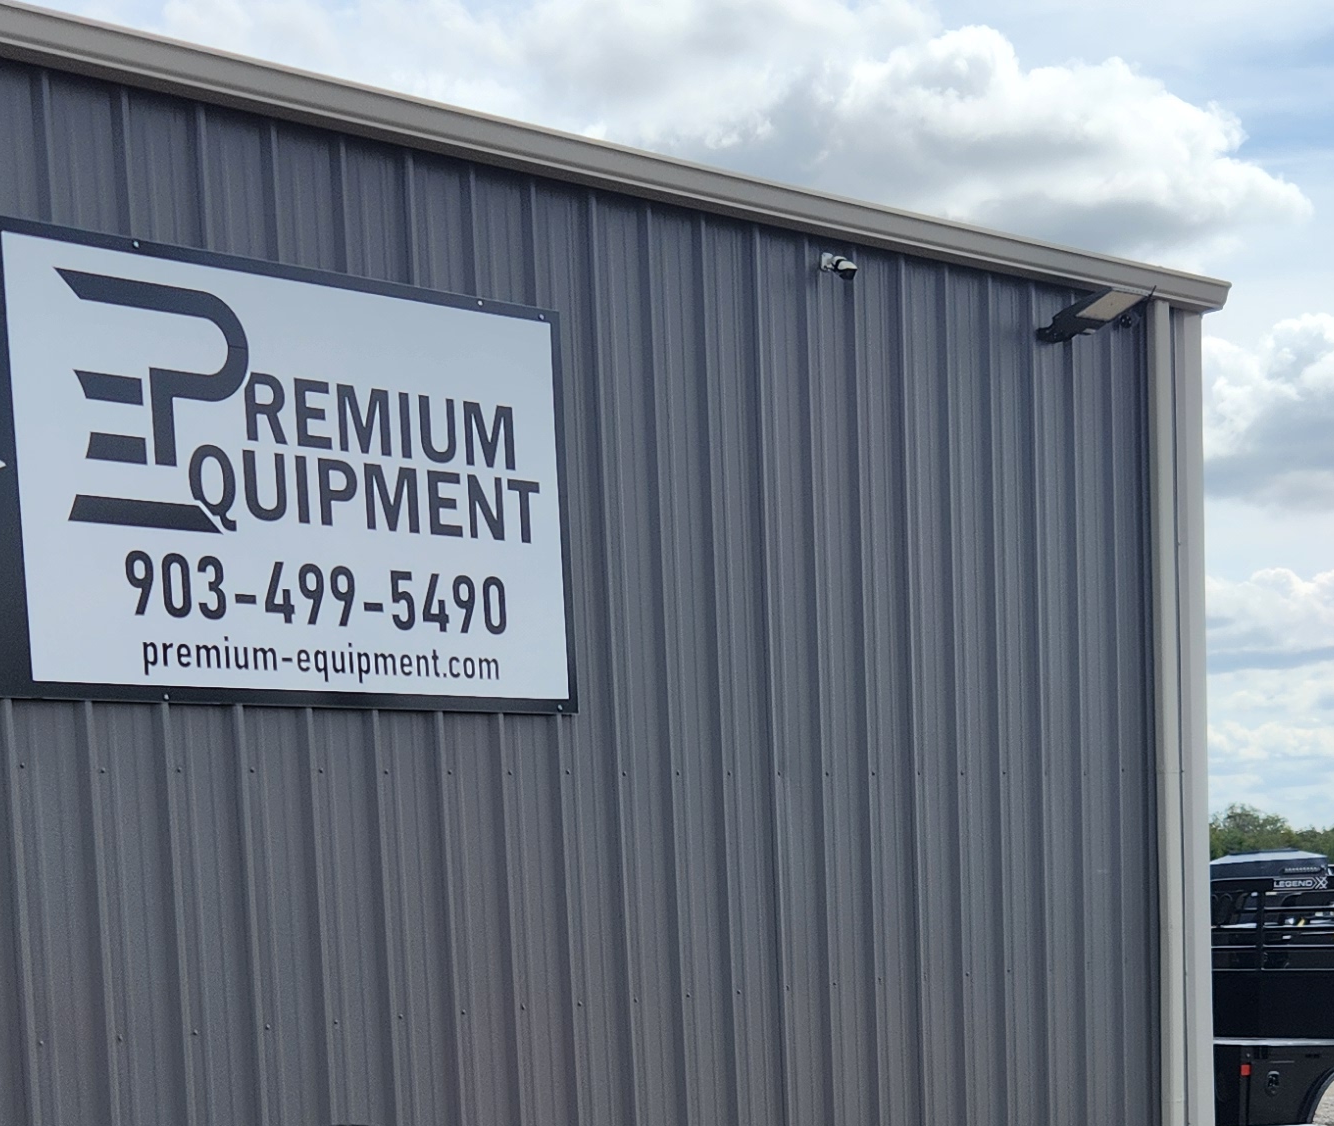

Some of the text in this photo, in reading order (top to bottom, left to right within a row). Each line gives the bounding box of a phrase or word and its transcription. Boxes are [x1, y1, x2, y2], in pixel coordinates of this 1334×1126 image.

[54, 267, 517, 471] PREMIUM
[124, 549, 508, 636] 903-499-5490
[142, 636, 500, 684] premium-equipment.com
[1273, 880, 1313, 888] LEGEND
